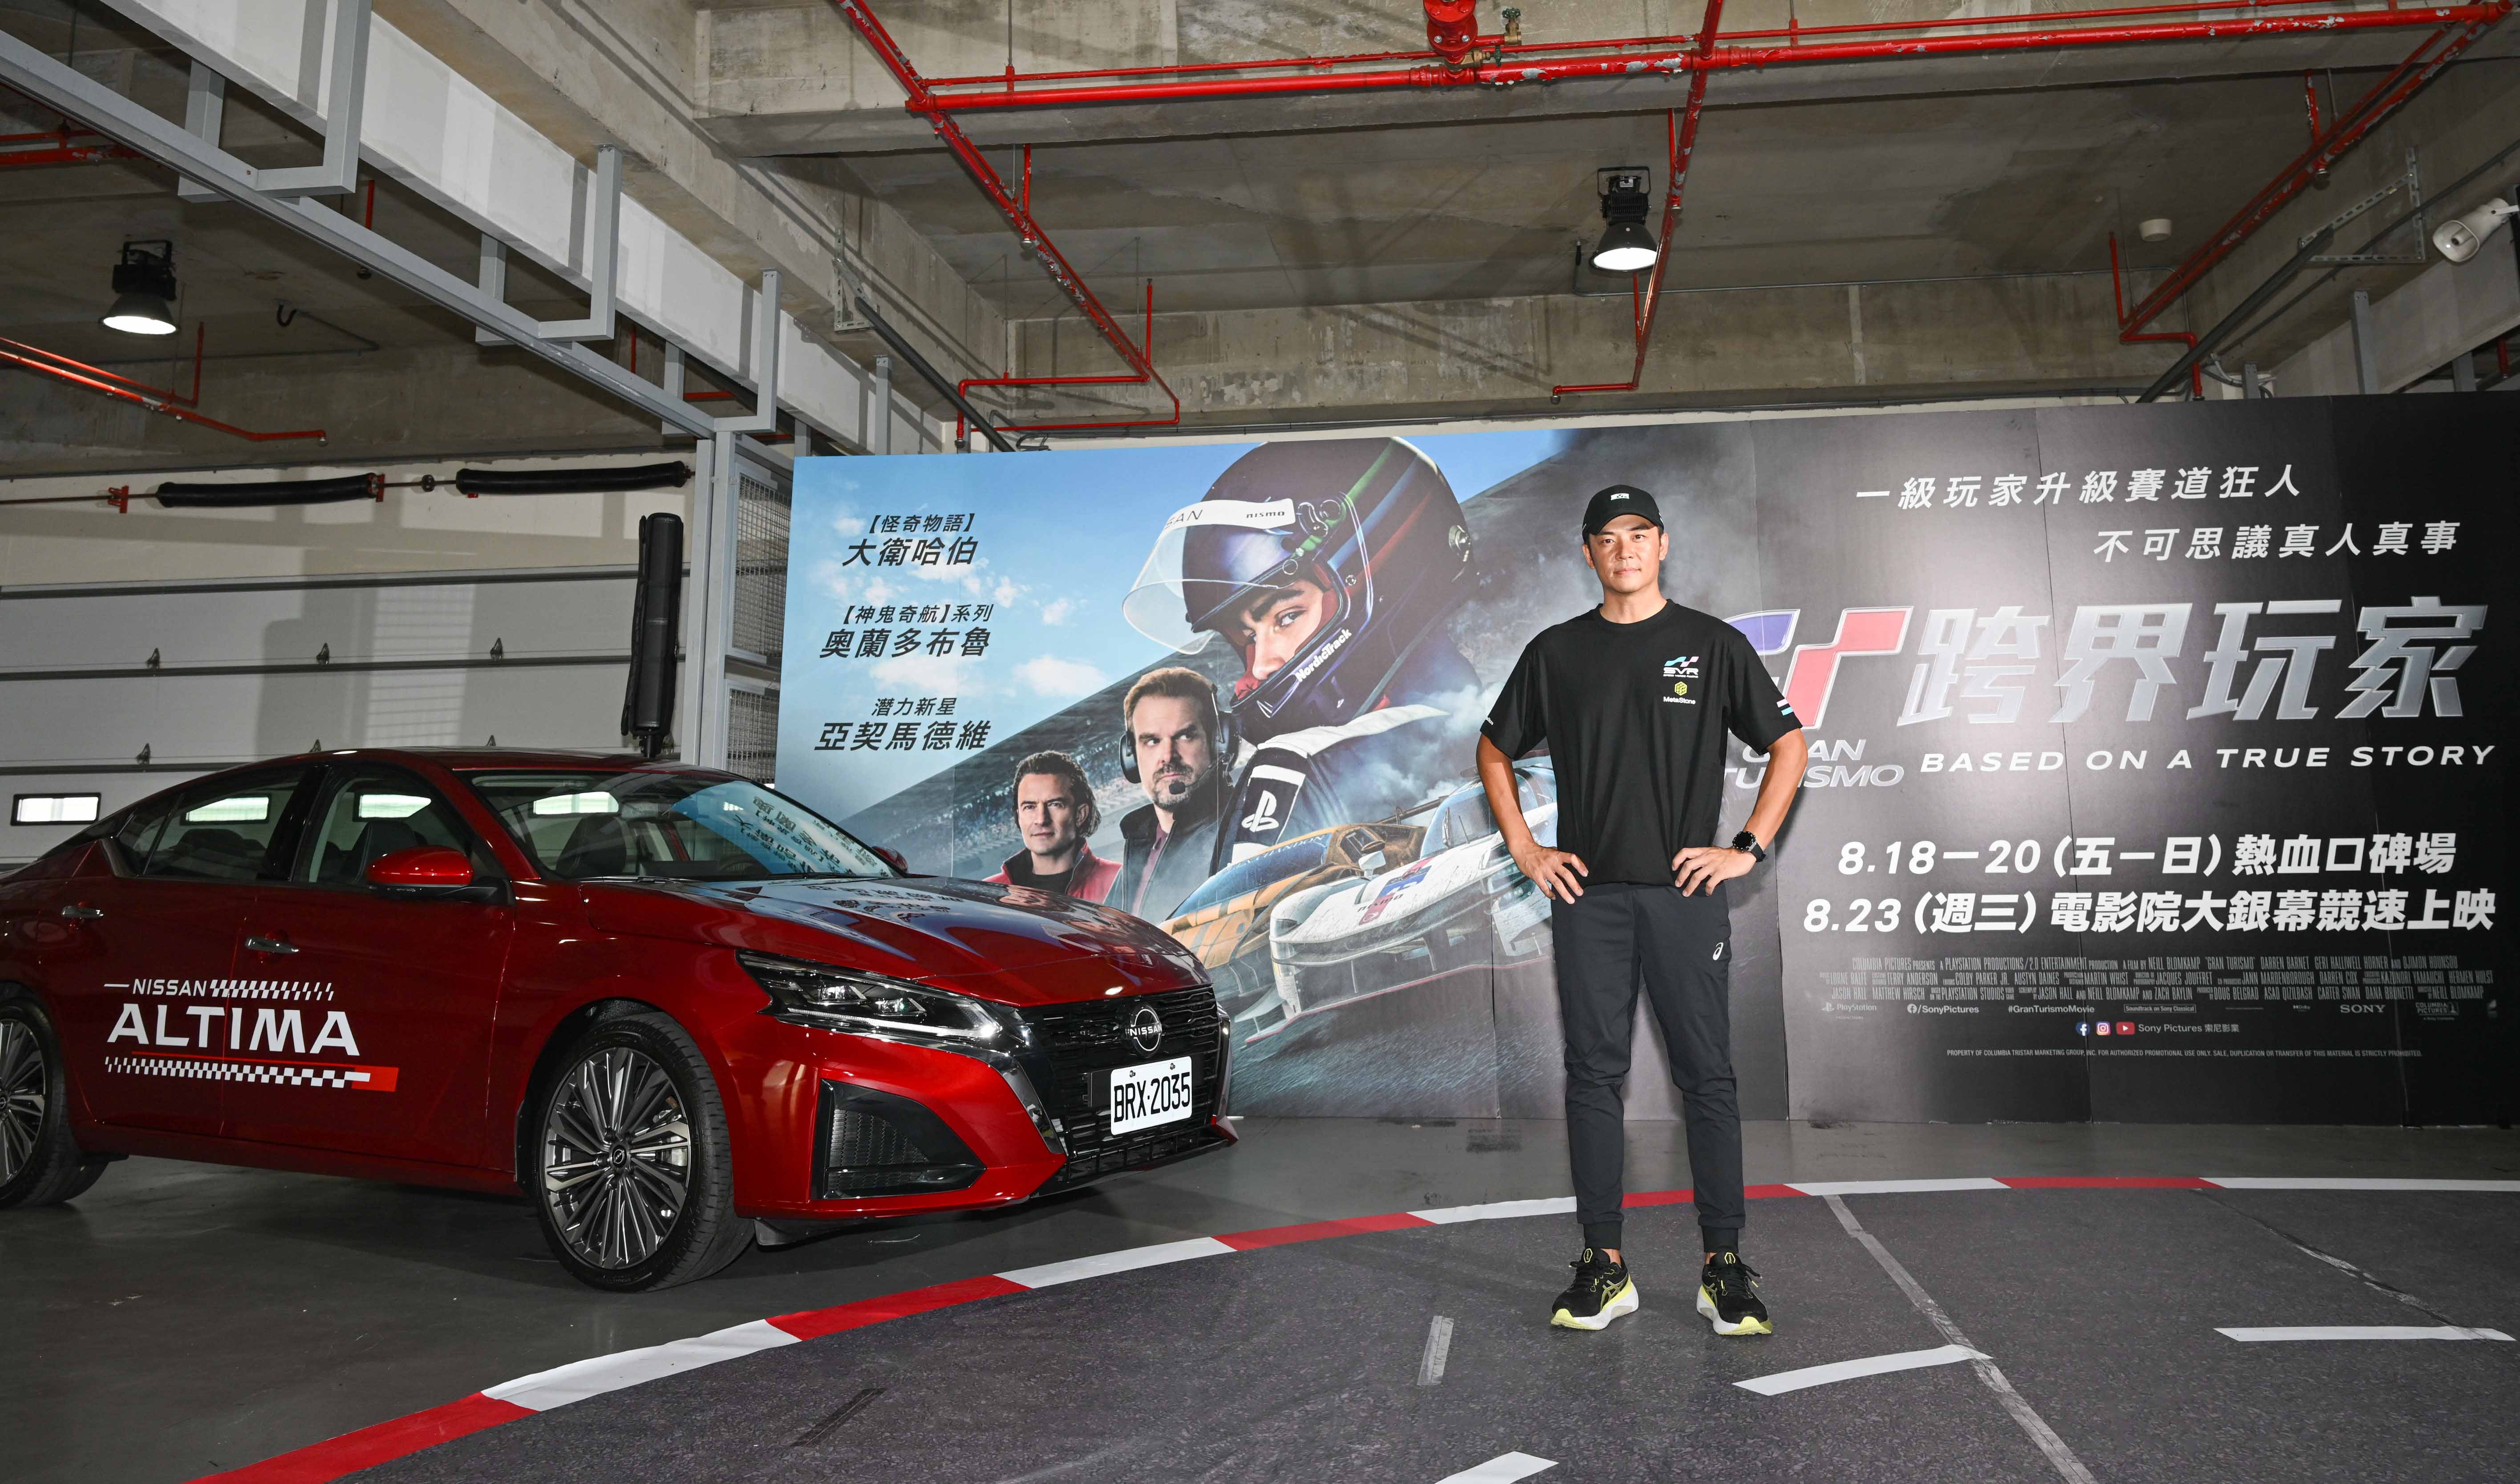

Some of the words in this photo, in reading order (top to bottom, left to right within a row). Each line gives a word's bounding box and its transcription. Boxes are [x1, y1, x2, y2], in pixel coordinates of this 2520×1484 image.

[1856, 465, 2301, 510] 一級玩家升級賽道狂人
[868, 513, 975, 533] 【怪奇物語】
[842, 536, 979, 566] 大衛哈伯
[2093, 521, 2460, 563] 不可思議真人真事
[843, 604, 994, 624] 【神鬼奇航】系列
[819, 627, 991, 658] 奧蘭多布魯
[1295, 629, 1352, 682] NordicTrack
[1896, 596, 2488, 726] 跨界玩家
[871, 697, 957, 716] 潛力新星
[1663, 696, 1696, 705] MetaStone
[814, 720, 991, 751] 亞契馬德維
[1920, 751, 2064, 772] BASED
[2086, 750, 2147, 770] ON
[2167, 750, 2192, 769] A
[2216, 747, 2330, 768] TRUE
[2350, 745, 2495, 766] STORY
[1852, 957, 1882, 970] COLUMBIA
[1884, 957, 1911, 970] PICTURES
[1913, 960, 1935, 970] PRESENTS
[1945, 957, 1981, 970] PLAYSTATION
[2041, 957, 2087, 970] ENTERTAINMENT
[2089, 960, 2118, 970] PRODUCTION
[2127, 960, 2139, 970] FILM
[2140, 960, 2146, 970] BY
[2148, 957, 2164, 970] NEILL
[2167, 957, 2200, 970] BLOMKAMP
[2261, 956, 2284, 969] DARREN
[133, 979, 207, 997] NISSAN
[1887, 972, 1904, 985] TERRY
[1907, 972, 1938, 985] ANDERSON
[1955, 972, 1973, 985] COLBY
[1976, 972, 1998, 985] PARKER
[2014, 972, 2037, 985] AUSTYN
[2039, 972, 2060, 985] DAINES
[2084, 972, 2107, 985] MARTIN
[2110, 972, 2128, 985] WHIST
[2156, 972, 2182, 986] JACQUES
[2185, 972, 2212, 985] JOUFFRET
[2261, 971, 2315, 985] MARDENBOROUGH
[2320, 971, 2344, 985] DARREN
[2346, 971, 2358, 984] COX
[1832, 987, 1852, 1000] JASON
[1872, 987, 1900, 1000] MATTHEW
[1903, 987, 1925, 1000] HIRSCH
[1941, 987, 1977, 1000] PLAYSTATION
[1980, 987, 2005, 1000] STUDIOS
[2038, 987, 2057, 1000] JASON
[2059, 987, 2074, 1000] HALL
[2087, 987, 2103, 1000] NEILL
[2106, 987, 2139, 1000] BLOMKAMP
[2155, 987, 2170, 1000] ZACH
[2172, 987, 2193, 1000] BAYLIN
[2214, 987, 2231, 1000] DOUG
[2233, 987, 2259, 1000] BELGRAD
[2265, 987, 2280, 1000] ASAD
[2318, 987, 2340, 1000] CARTER
[1837, 1004, 1877, 1012] PlayStation
[2008, 1005, 2095, 1014] #GranTurismoMovie
[2160, 1006, 2172, 1014] Sony
[2340, 1005, 2386, 1014] SONY
[107, 1003, 360, 1056] ALTIMA
[1129, 1025, 1163, 1036] NISSAN
[2138, 1024, 2161, 1033] Sony
[2164, 1024, 2202, 1032] Pictures
